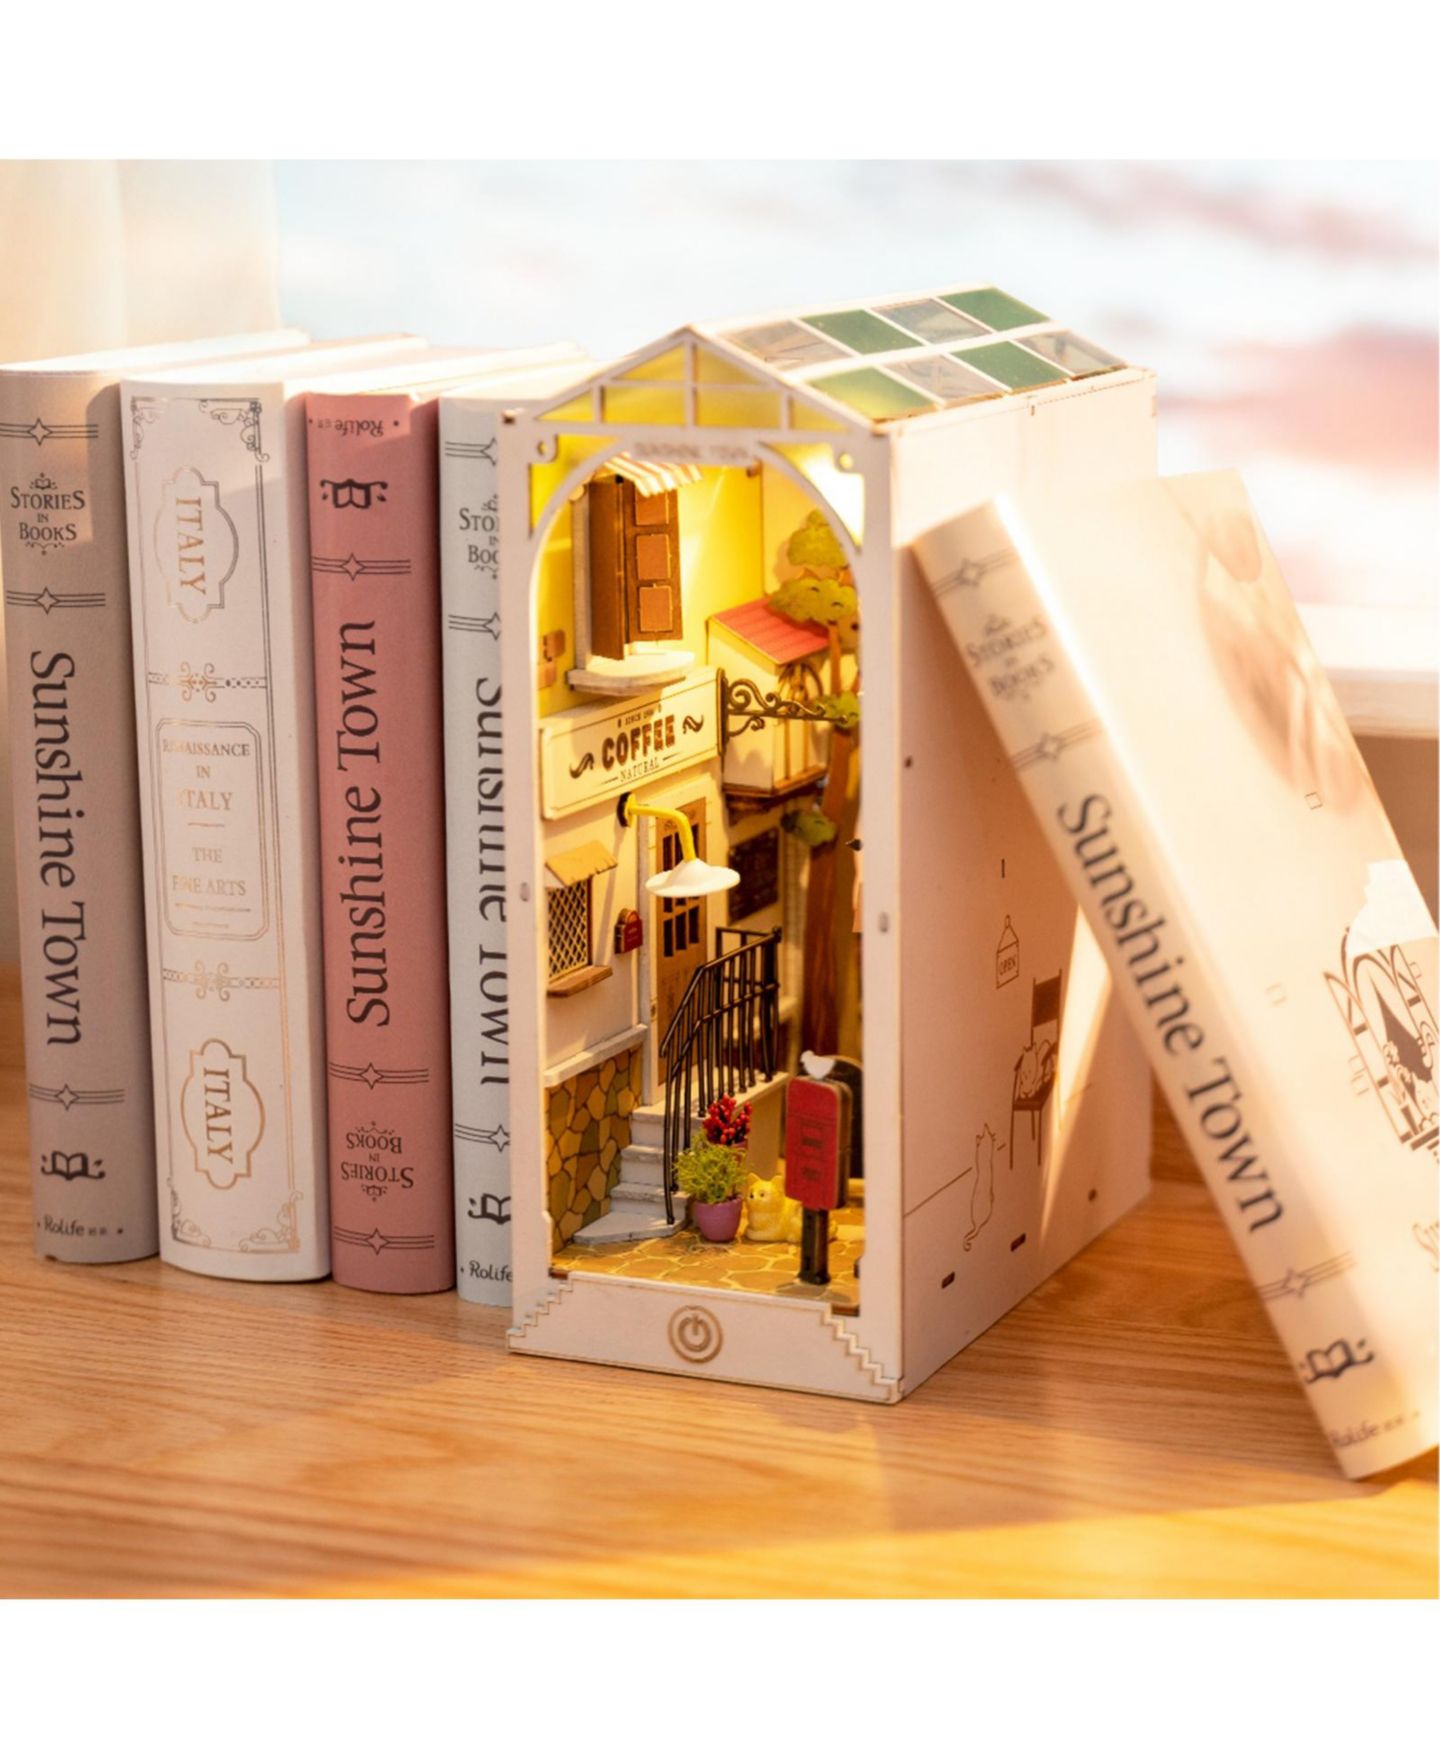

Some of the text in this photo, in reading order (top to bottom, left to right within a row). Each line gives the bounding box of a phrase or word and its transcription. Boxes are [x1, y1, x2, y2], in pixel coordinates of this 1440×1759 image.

[335, 419, 384, 437] Rolife
[10, 485, 85, 510] STORIES
[37, 513, 49, 524] IN
[19, 522, 77, 541] BOOKS
[176, 497, 206, 595] ITALY
[602, 714, 676, 770] COFFEE
[196, 765, 211, 779] IN
[620, 757, 660, 783] NATURAL
[335, 620, 390, 1027] Sunshine Town
[31, 650, 86, 1045] Sunshine Town
[191, 847, 223, 864] THE
[206, 879, 247, 898] ARTS
[1057, 793, 1285, 1235] Sunshine Town
[203, 1068, 233, 1165] ITALY
[346, 1132, 402, 1154] BOOKS
[368, 1152, 380, 1163] IN
[340, 1161, 415, 1189] STORIES
[43, 1213, 84, 1237] Rolife
[469, 1260, 512, 1283] Rolife
